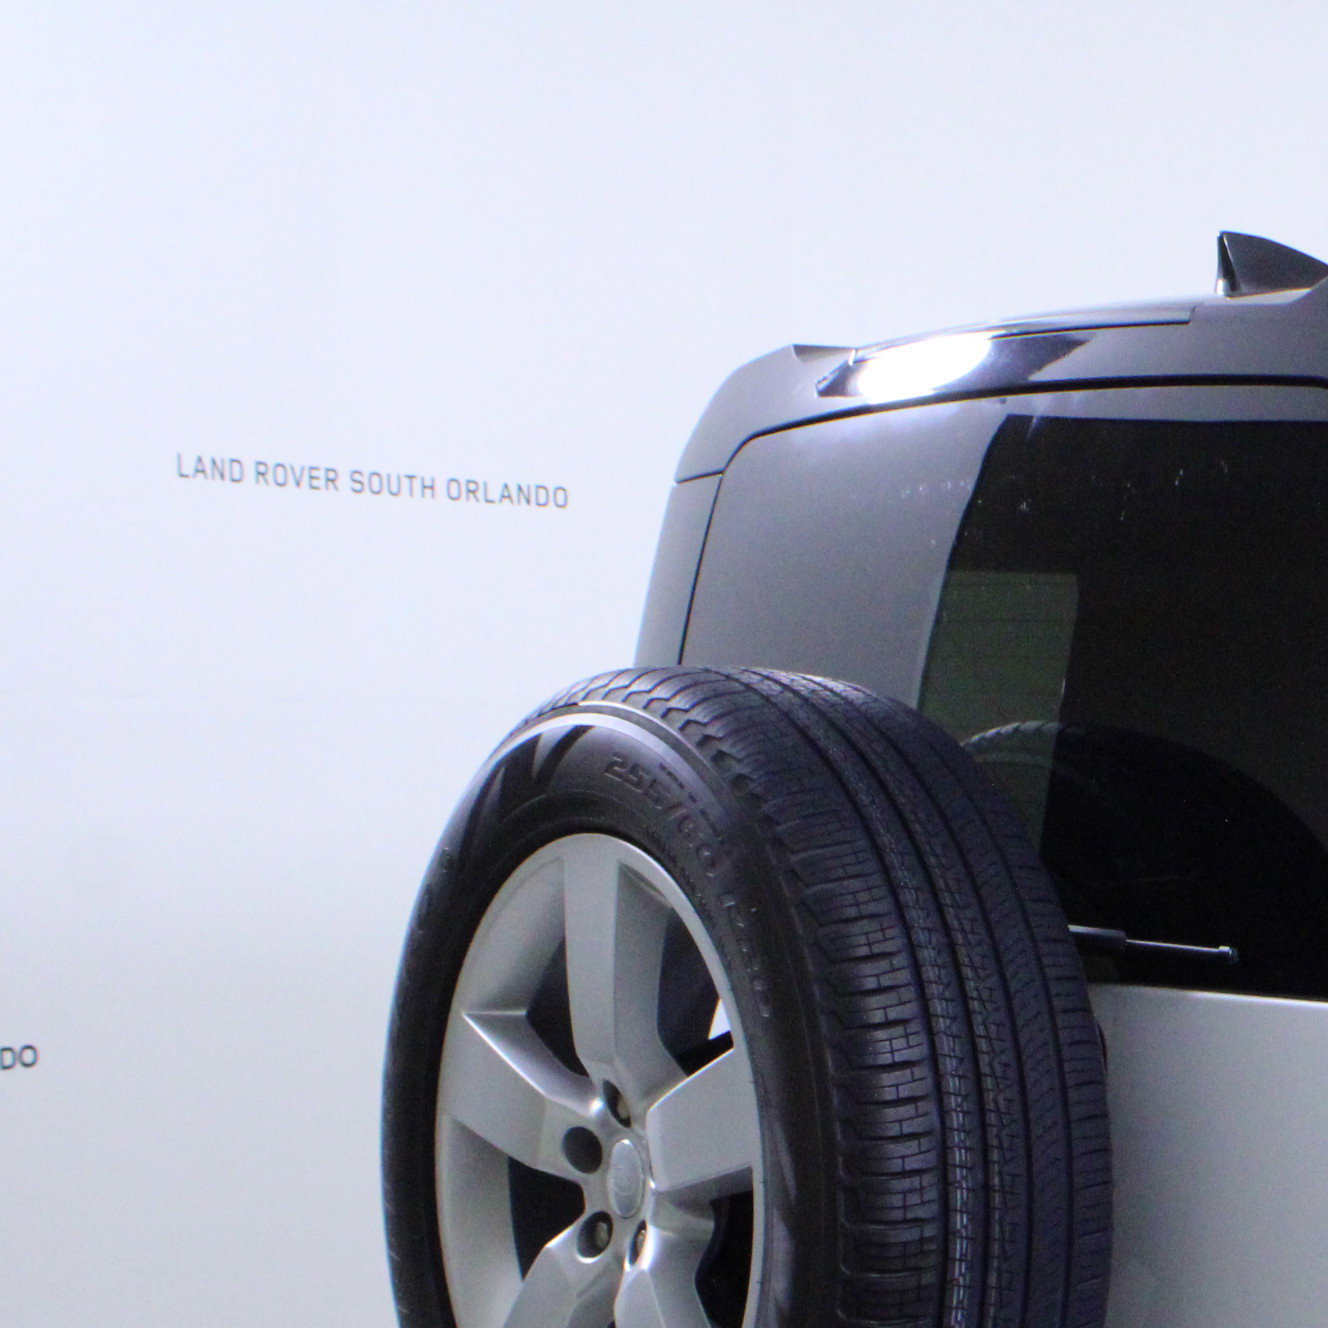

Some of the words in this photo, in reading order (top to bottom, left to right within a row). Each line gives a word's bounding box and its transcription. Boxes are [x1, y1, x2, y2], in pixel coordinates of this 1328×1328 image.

[177, 453, 244, 483] LAND
[255, 461, 339, 491] ROVER
[350, 470, 436, 499] SOUTH
[446, 478, 569, 509] ORLANDO
